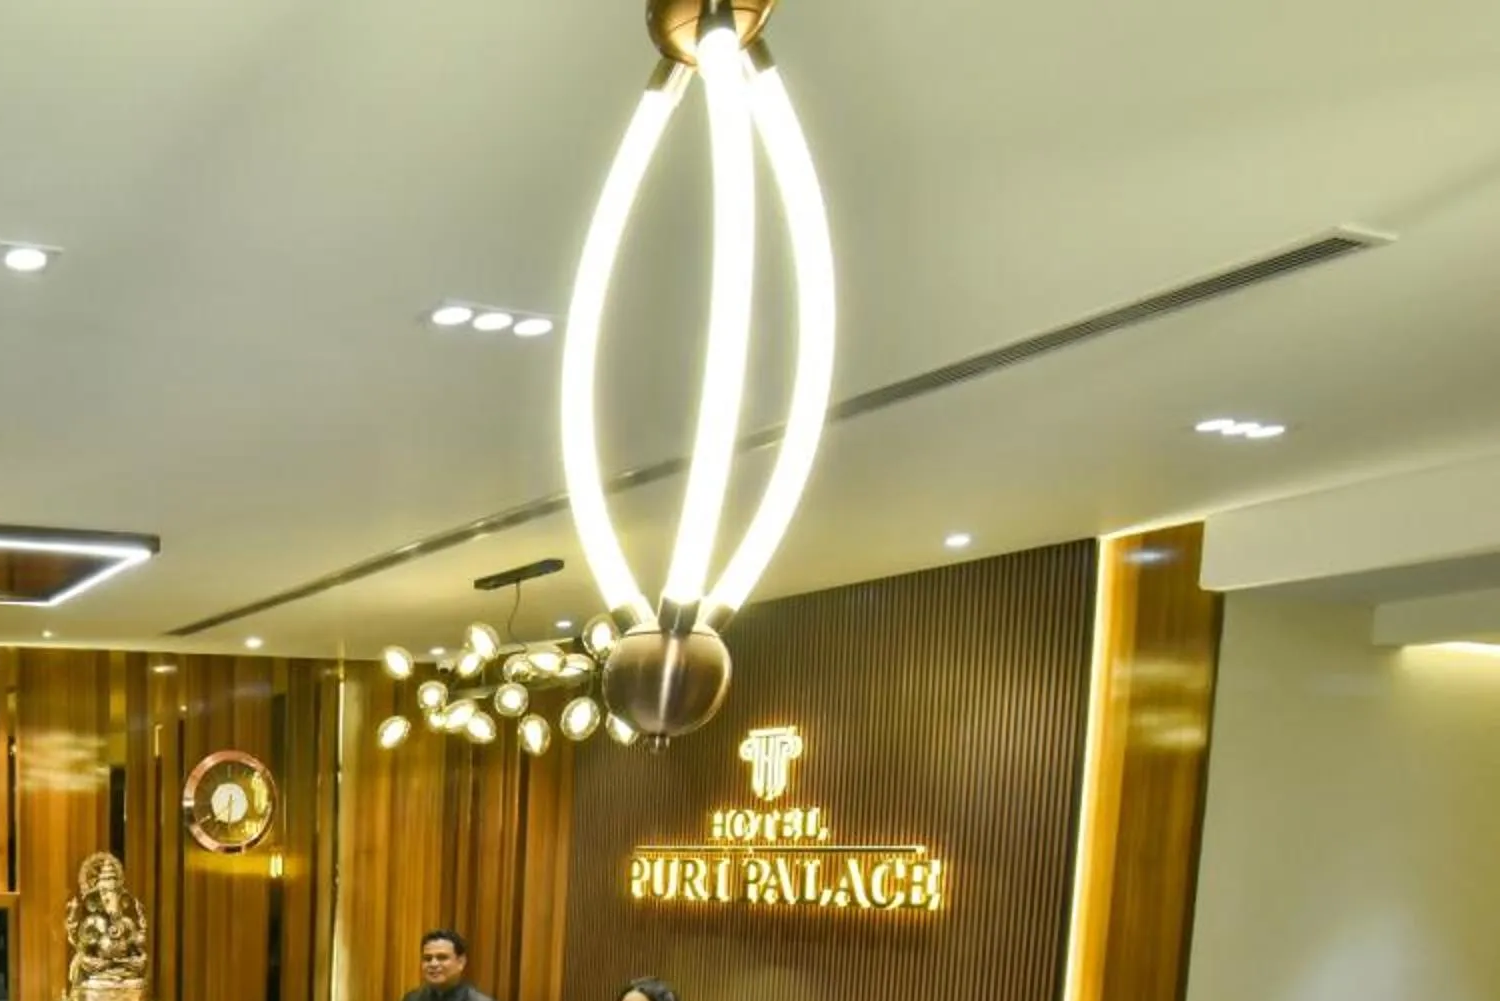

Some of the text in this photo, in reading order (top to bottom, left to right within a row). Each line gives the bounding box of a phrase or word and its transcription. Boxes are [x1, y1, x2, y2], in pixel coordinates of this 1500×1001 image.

[710, 809, 828, 841] HOTEL
[630, 857, 942, 909] PURI PALACE
